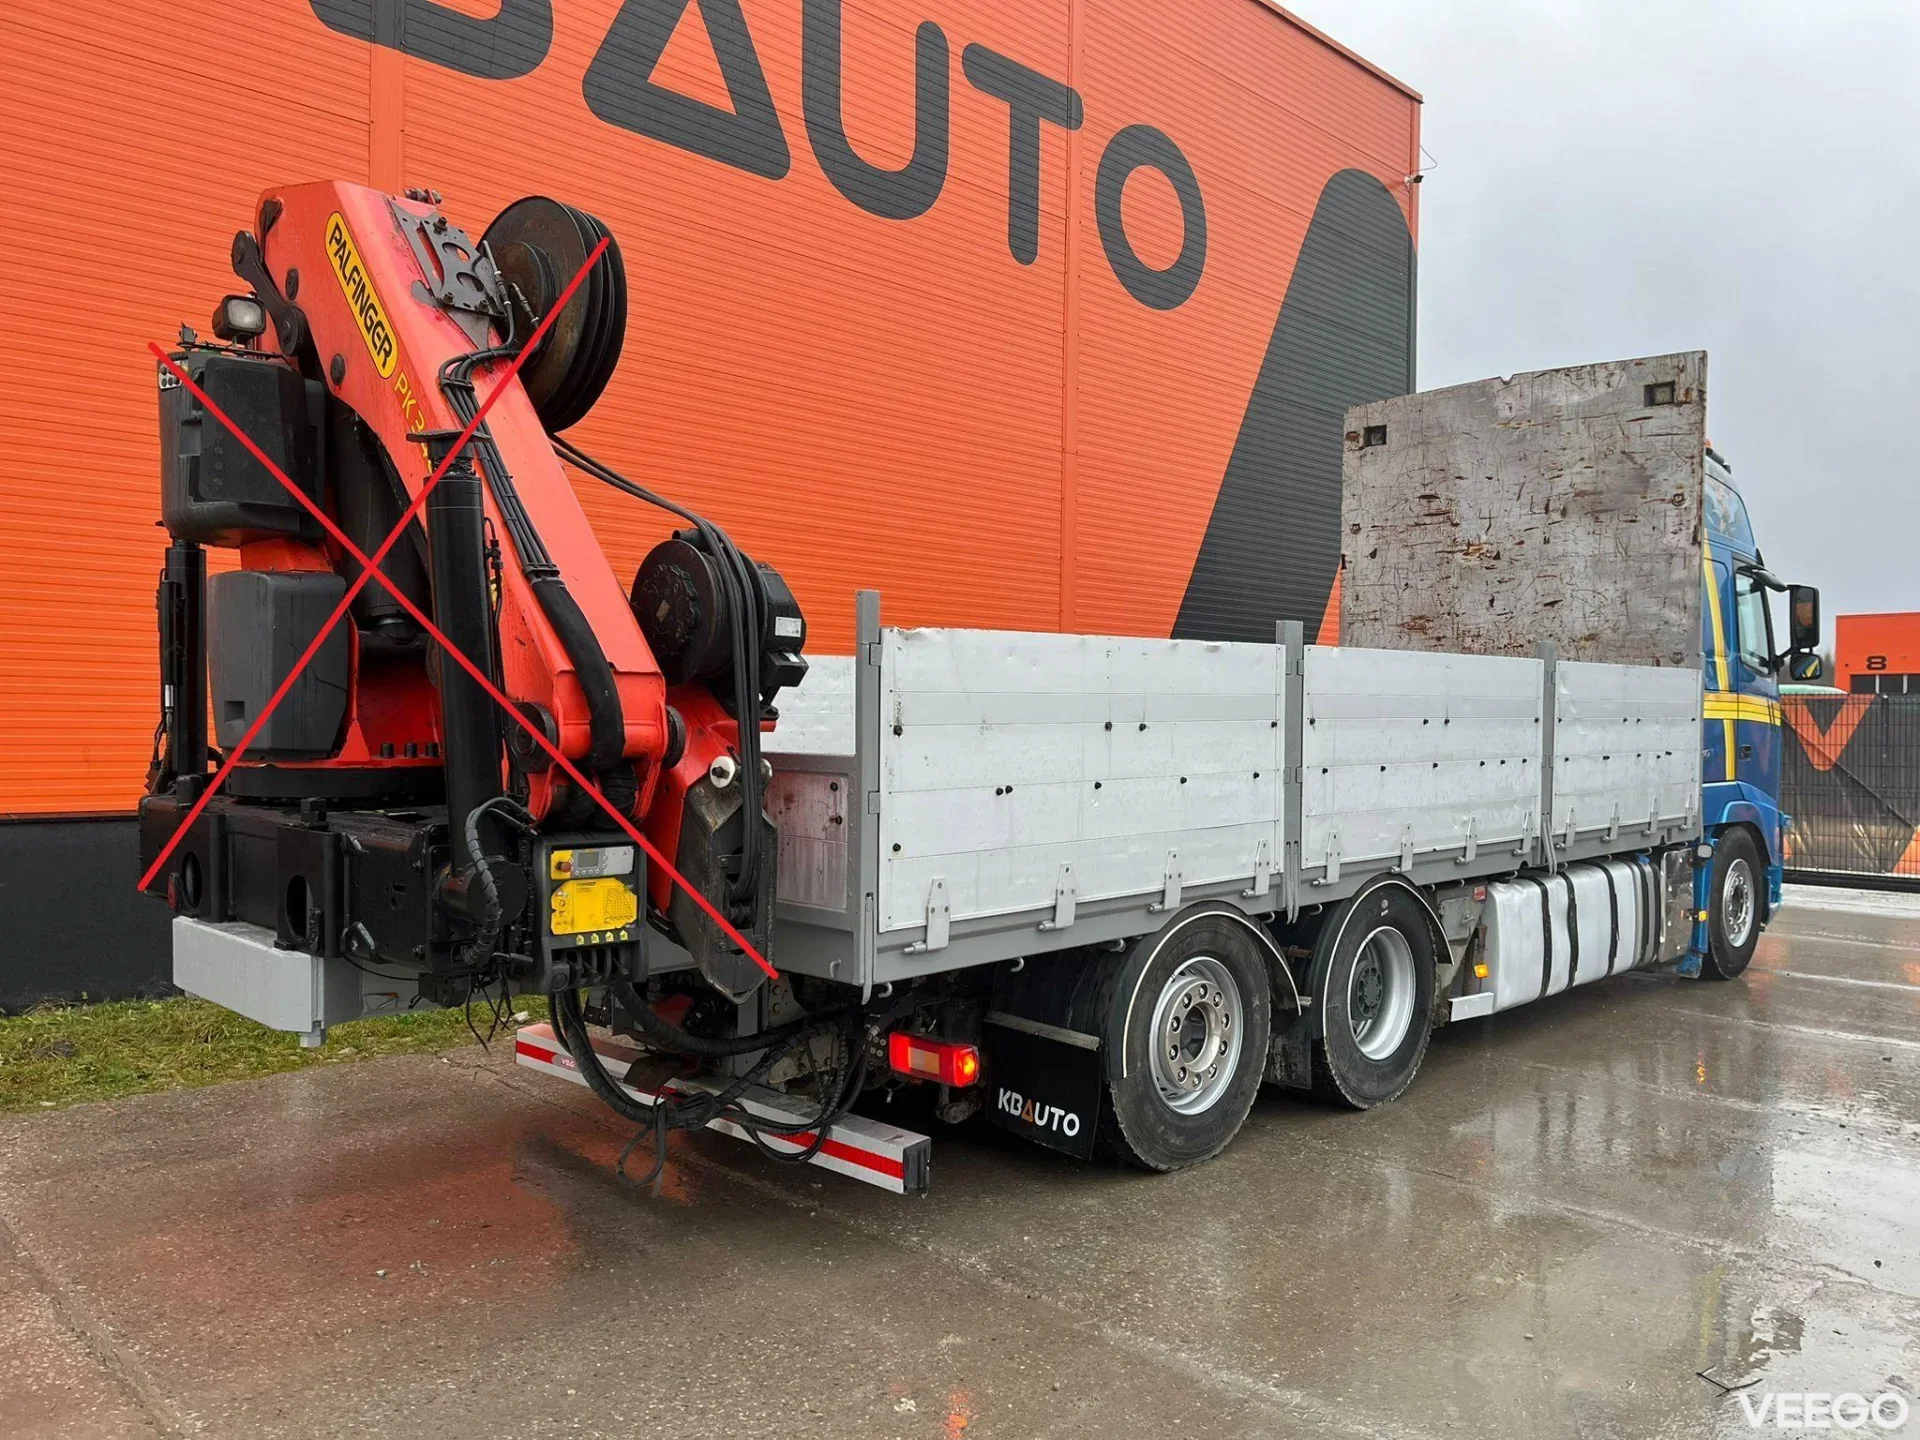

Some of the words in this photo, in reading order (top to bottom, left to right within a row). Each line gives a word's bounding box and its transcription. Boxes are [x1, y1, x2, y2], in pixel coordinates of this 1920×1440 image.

[328, 221, 393, 370] PALFINGER
[1866, 655, 1887, 671] 8
[997, 1087, 1080, 1137] KBAUTO
